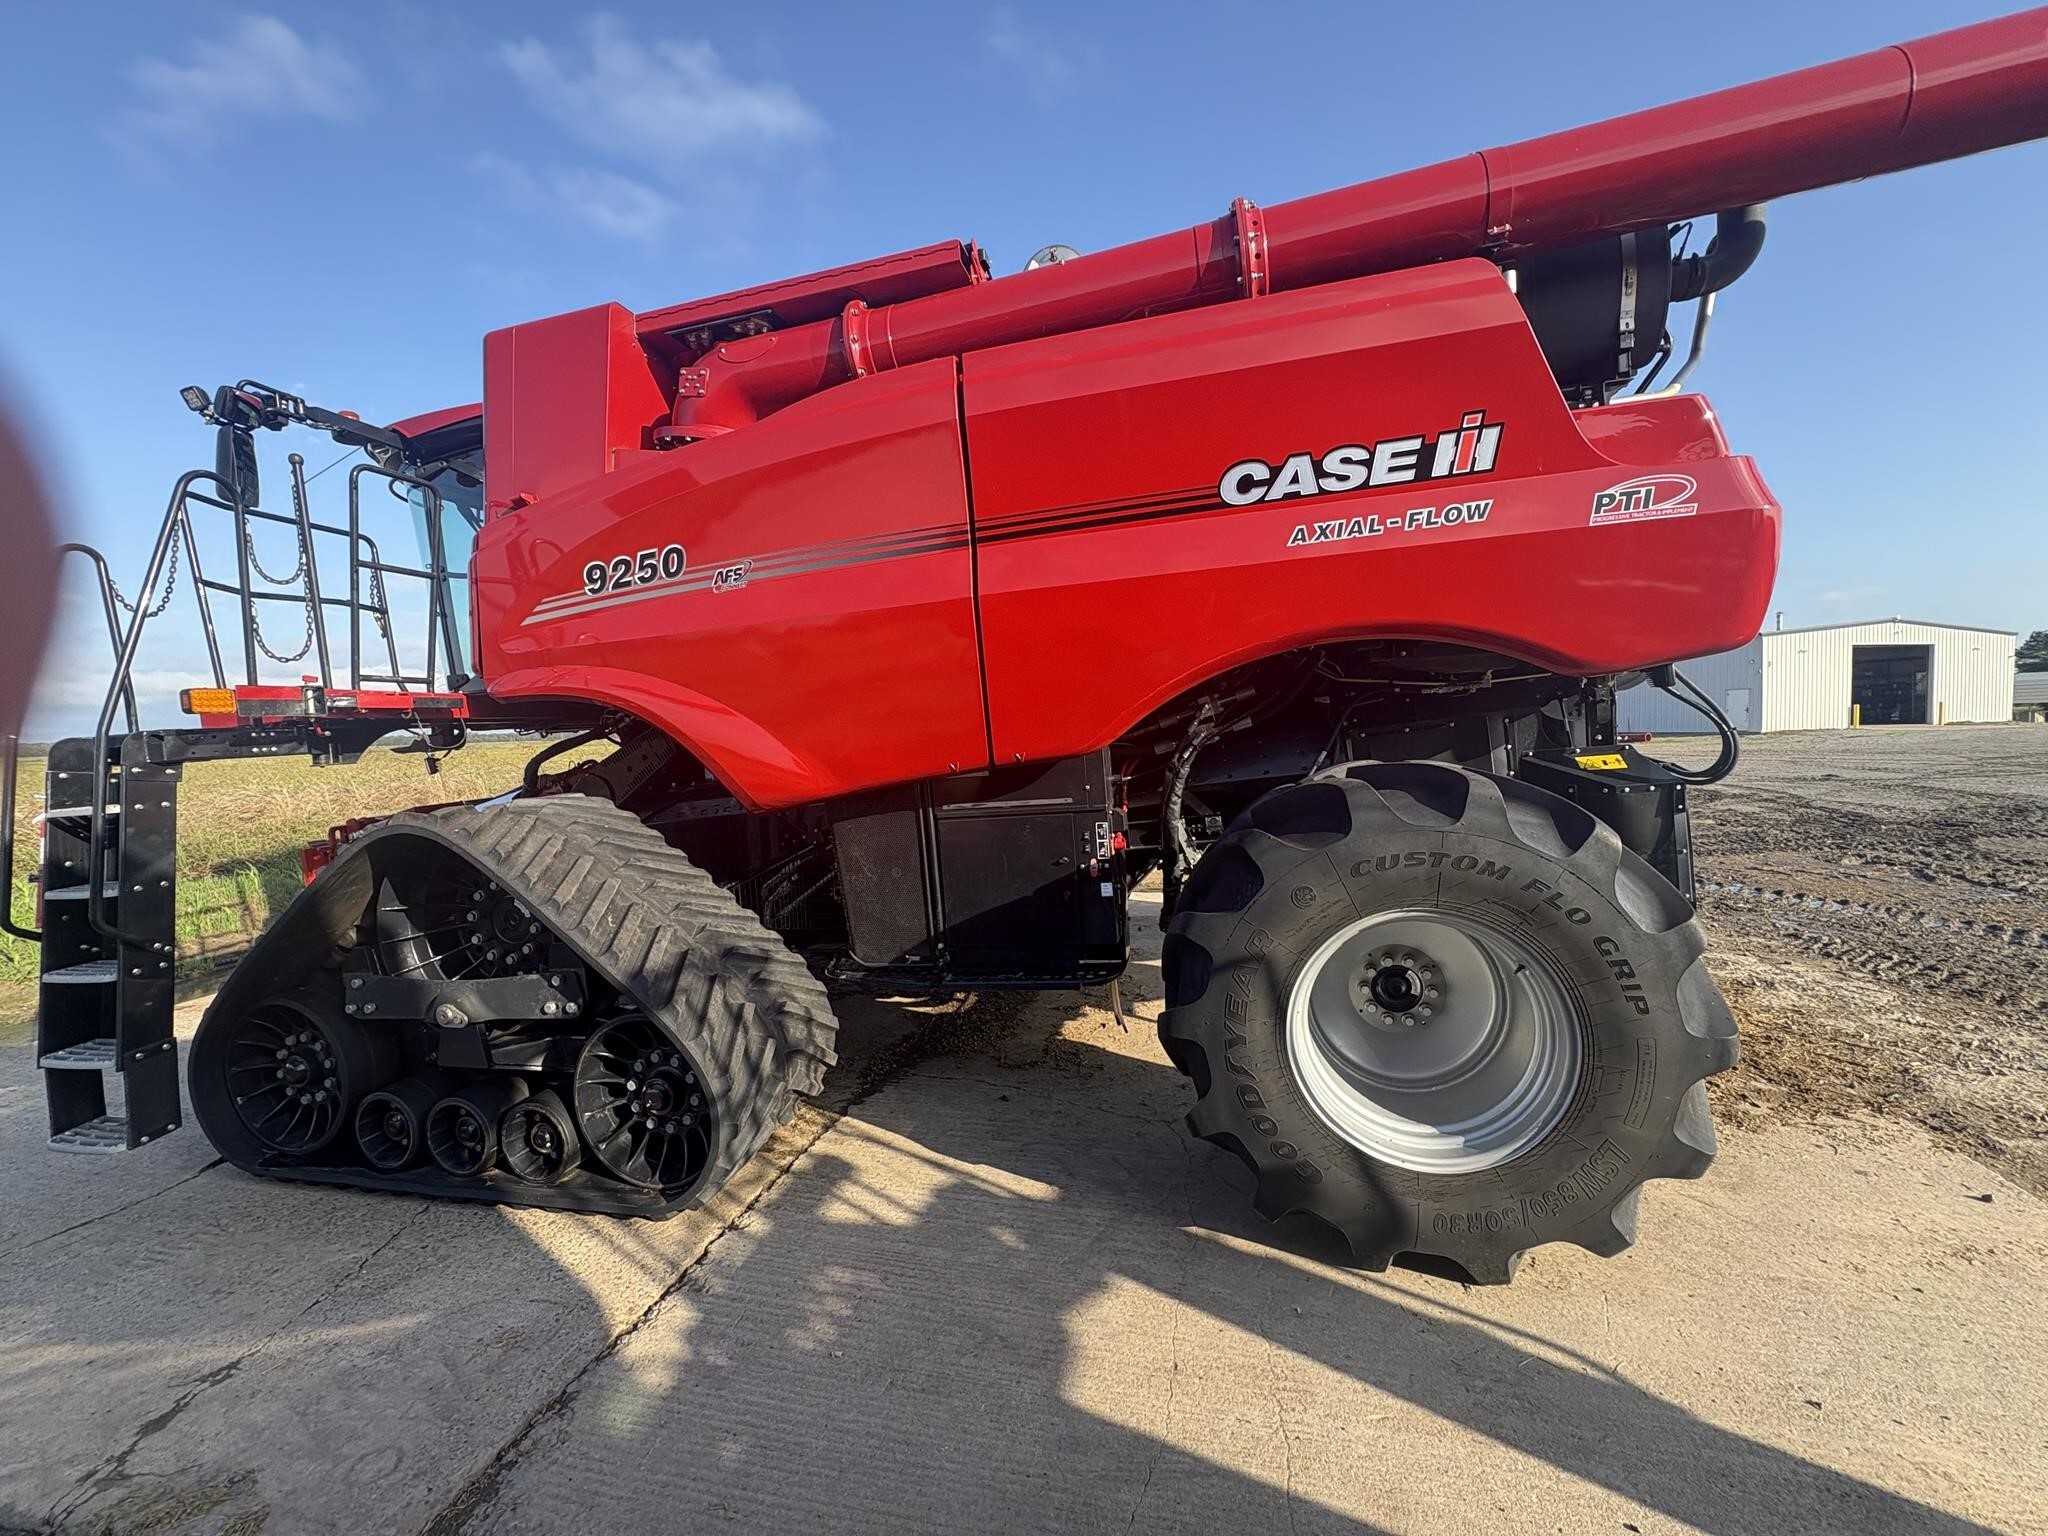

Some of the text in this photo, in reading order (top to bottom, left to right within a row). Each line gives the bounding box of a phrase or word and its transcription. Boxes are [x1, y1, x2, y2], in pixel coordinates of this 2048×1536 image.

[1219, 436, 1424, 506] CASE
[1593, 486, 1655, 515] PTI
[584, 544, 686, 596] 9250
[712, 565, 744, 586] AFS
[1350, 851, 1512, 881] CUSTOM
[1520, 877, 1592, 925] FLO
[1593, 935, 1650, 1015] GRIP
[1225, 928, 1324, 1185] GOODYEAR
